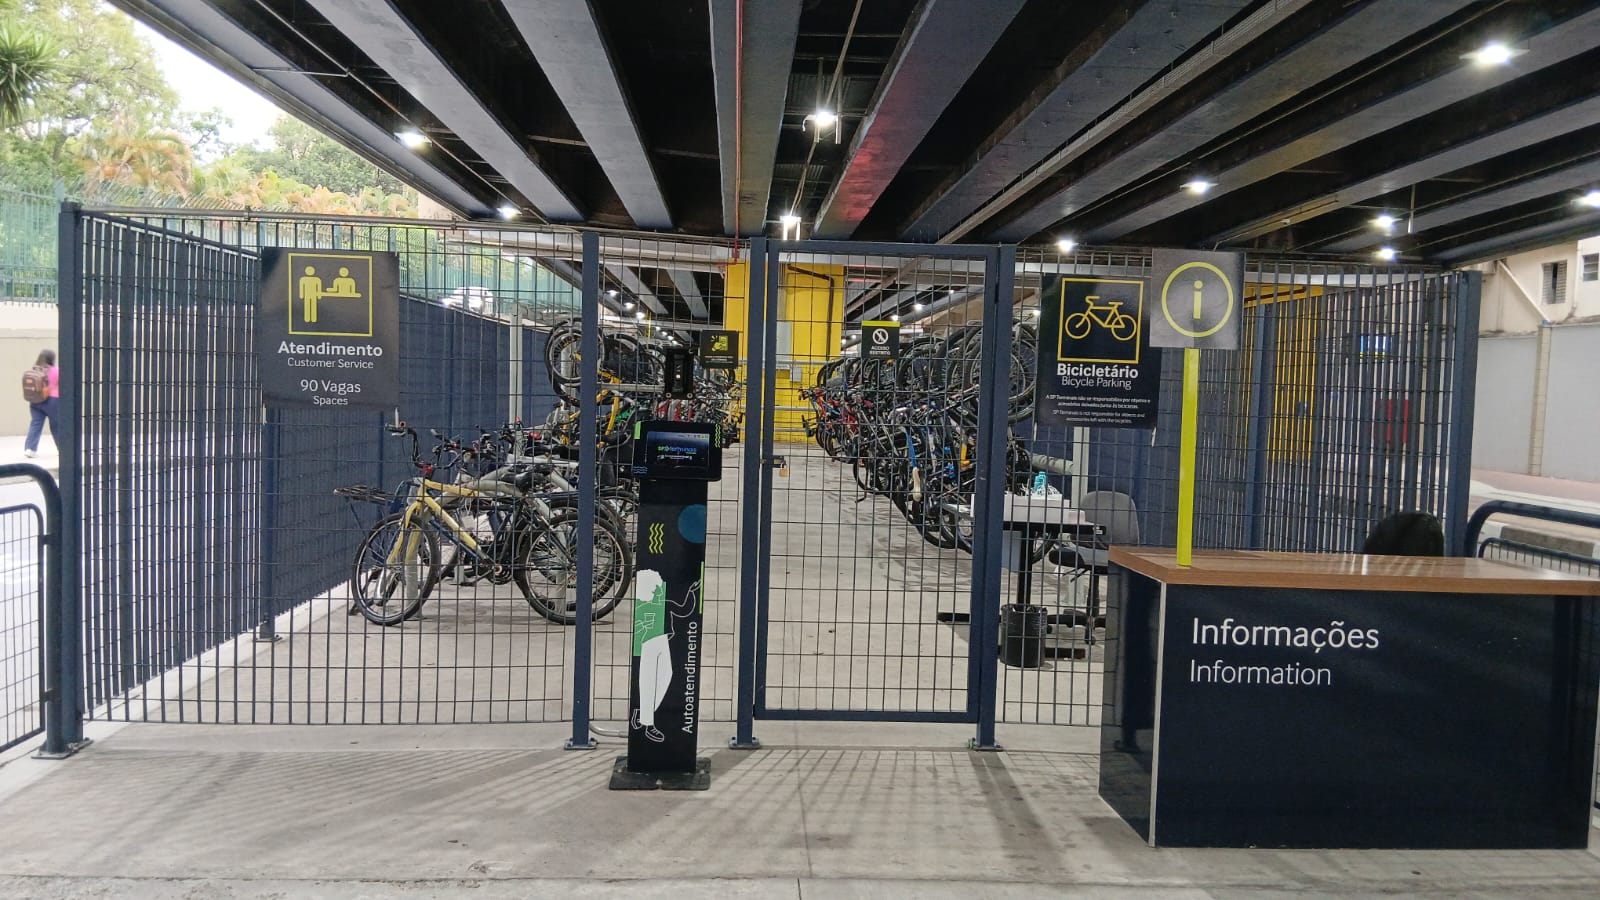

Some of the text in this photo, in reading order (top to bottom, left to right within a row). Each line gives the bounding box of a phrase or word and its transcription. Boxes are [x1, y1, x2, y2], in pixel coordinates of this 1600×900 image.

[278, 341, 383, 357] Atendimento
[287, 357, 374, 369] Customer Service
[1057, 363, 1139, 379] Bicicletário
[300, 379, 362, 395] 90 Vagas
[1061, 376, 1132, 391] Bicycle Parking
[313, 395, 349, 406] Spaces
[1192, 617, 1380, 654] Informações
[681, 621, 698, 734] Autoatendimento
[1190, 659, 1332, 686] Information
